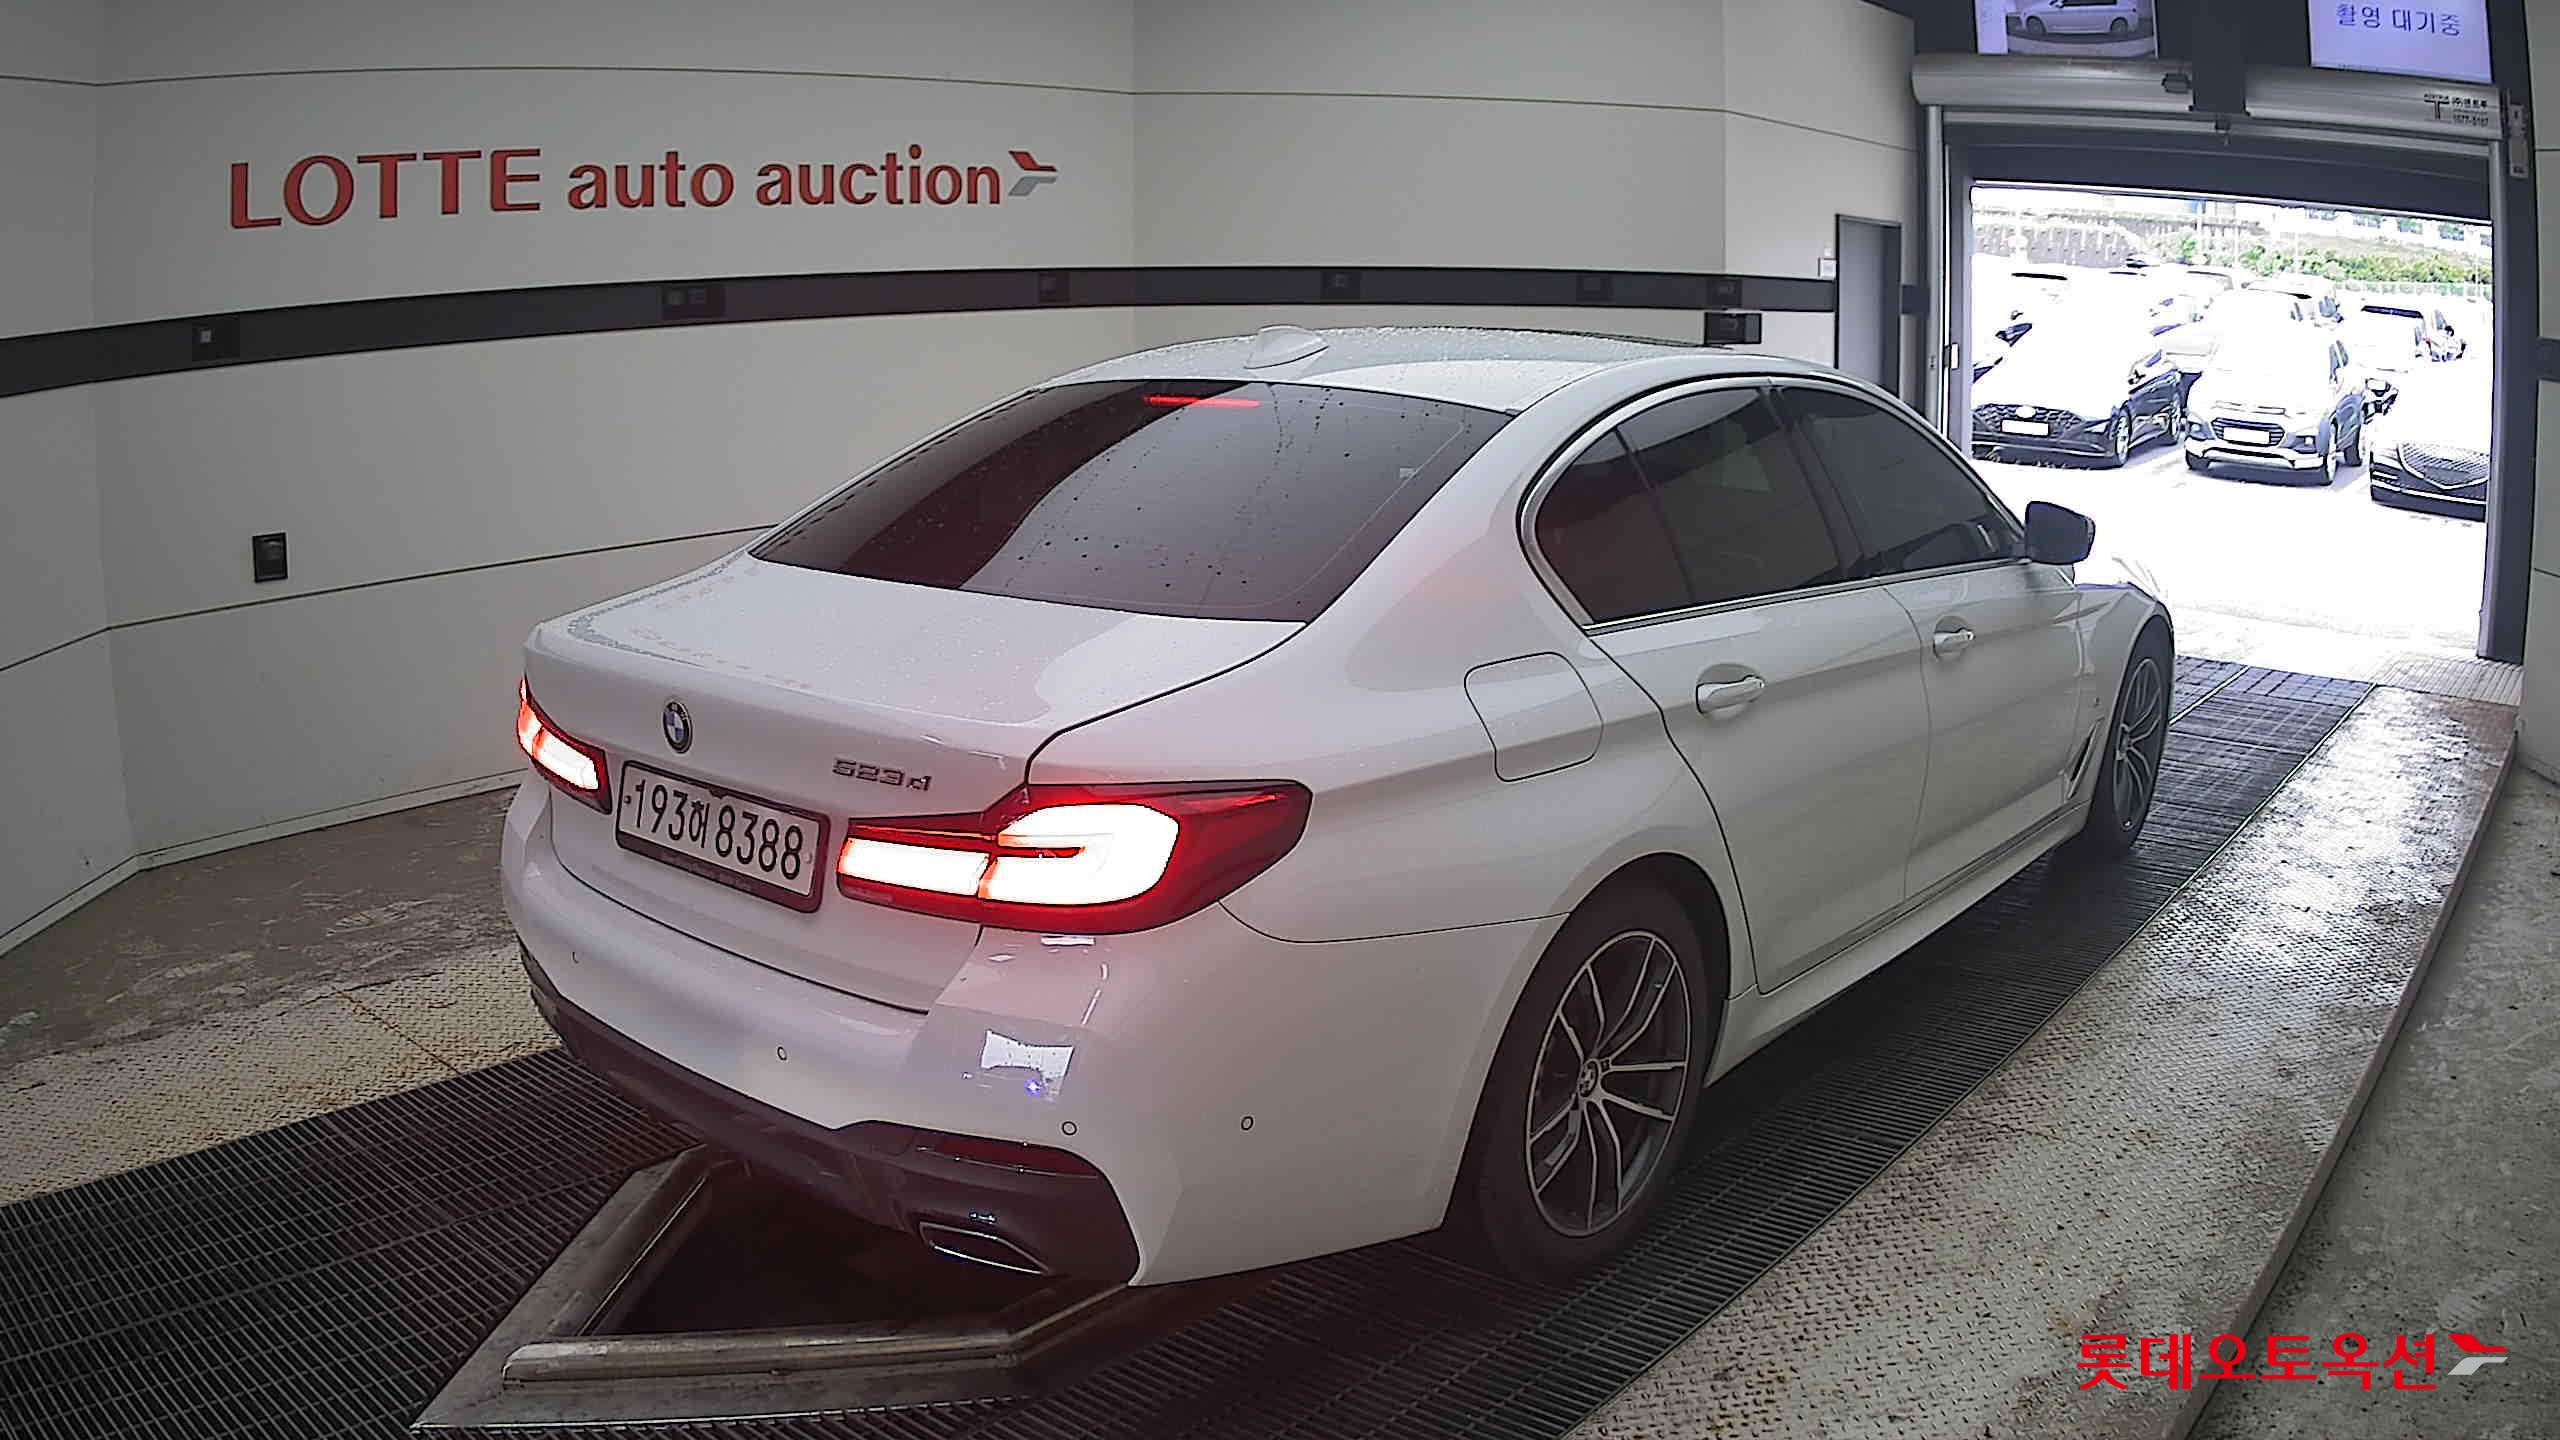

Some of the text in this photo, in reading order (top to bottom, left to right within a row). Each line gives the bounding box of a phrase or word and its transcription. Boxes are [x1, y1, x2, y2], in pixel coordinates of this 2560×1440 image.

[2337, 3, 2460, 36] 촬영 대기중
[230, 144, 1001, 229] LOTTE auto auction
